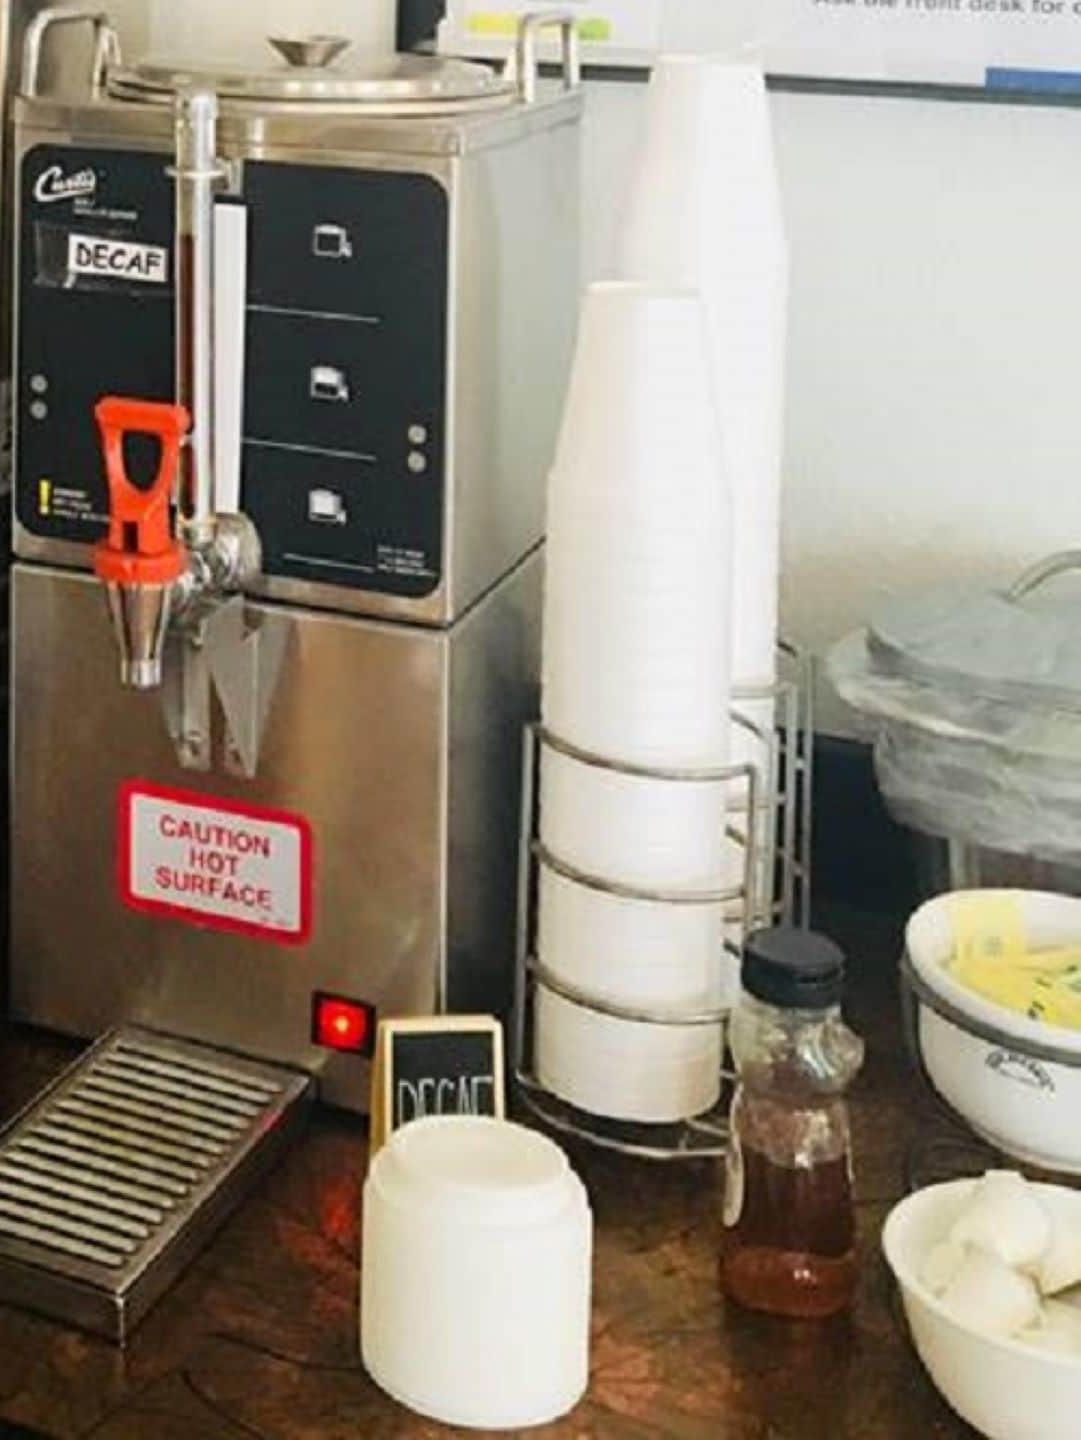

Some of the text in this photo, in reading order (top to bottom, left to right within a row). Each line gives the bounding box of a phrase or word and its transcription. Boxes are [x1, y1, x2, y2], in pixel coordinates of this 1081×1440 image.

[75, 241, 163, 276] DECAF
[158, 813, 271, 858] CAUTION
[189, 848, 239, 876] HOT
[155, 865, 273, 911] SURFACE
